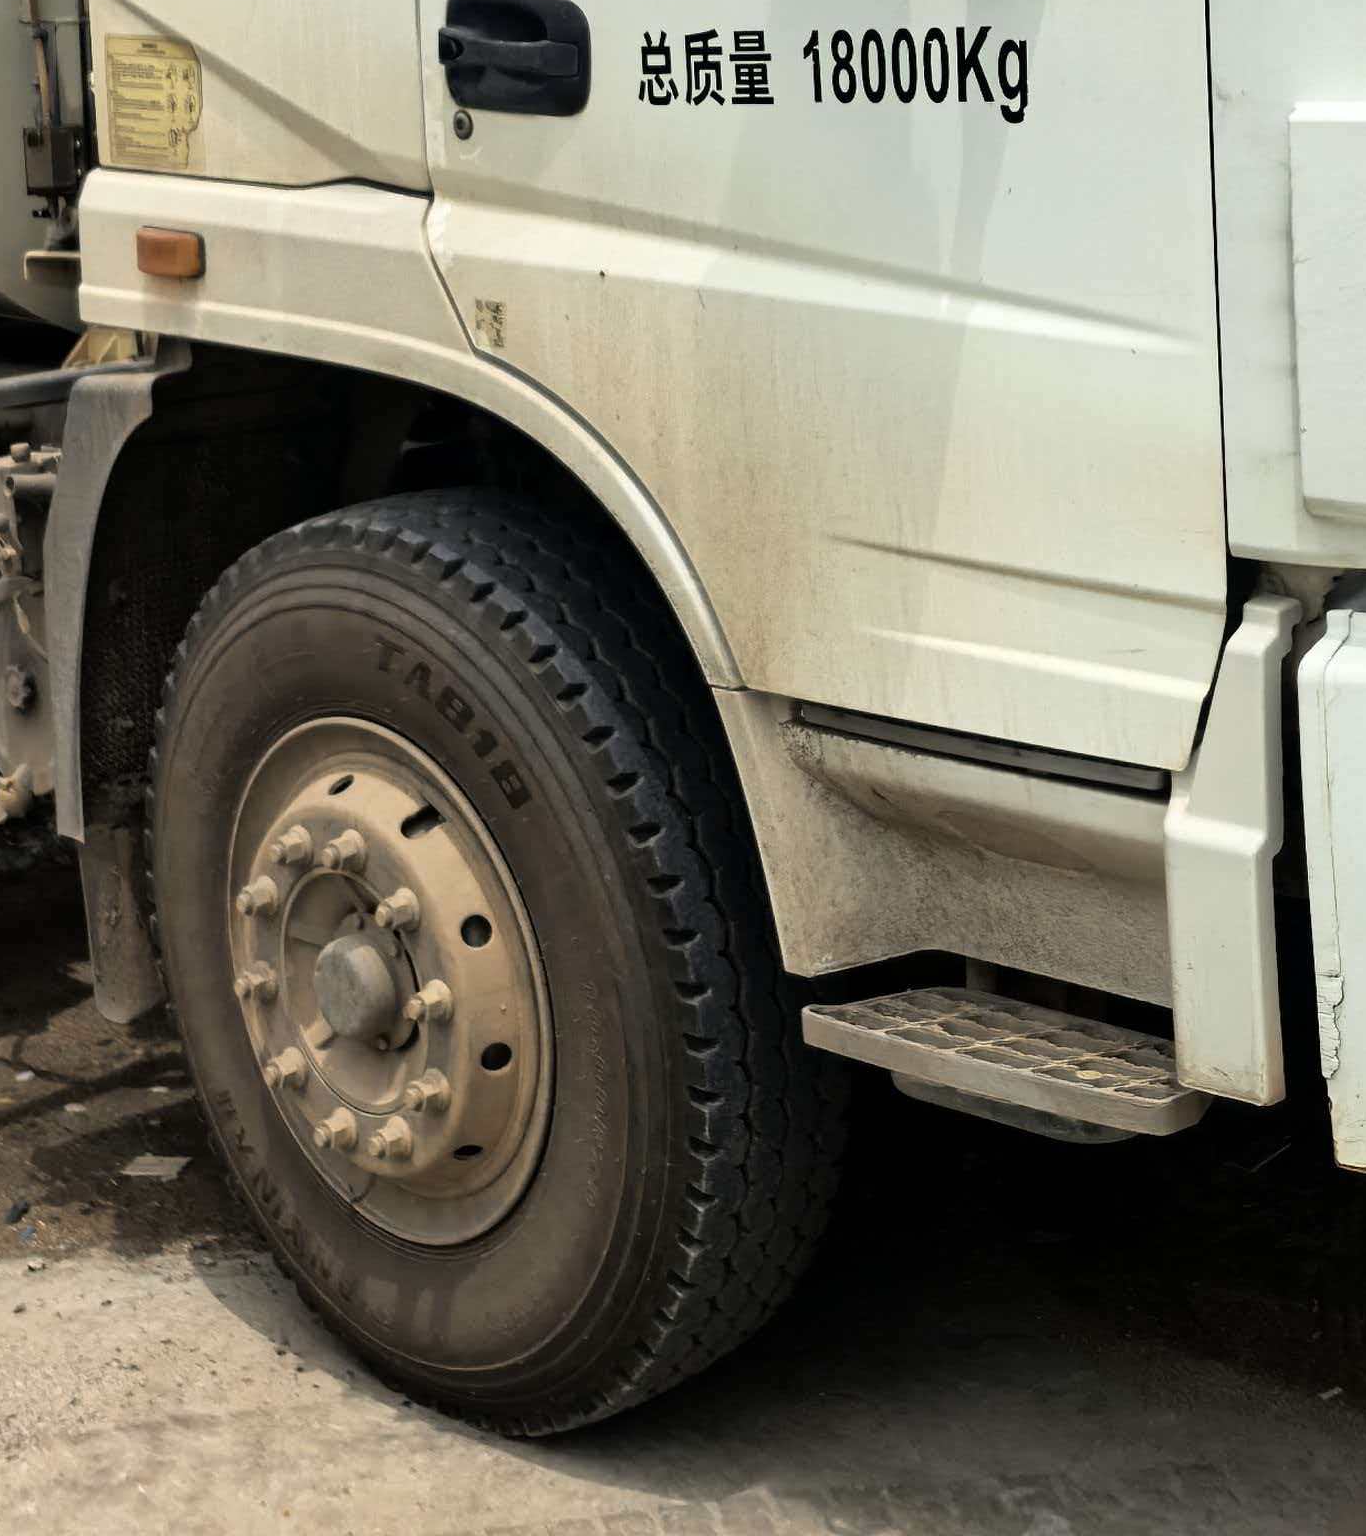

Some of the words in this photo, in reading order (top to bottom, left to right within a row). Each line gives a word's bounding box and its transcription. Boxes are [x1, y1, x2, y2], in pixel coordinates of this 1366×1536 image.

[638, 29, 775, 106] 总质量
[803, 25, 1029, 124] 18000Kg
